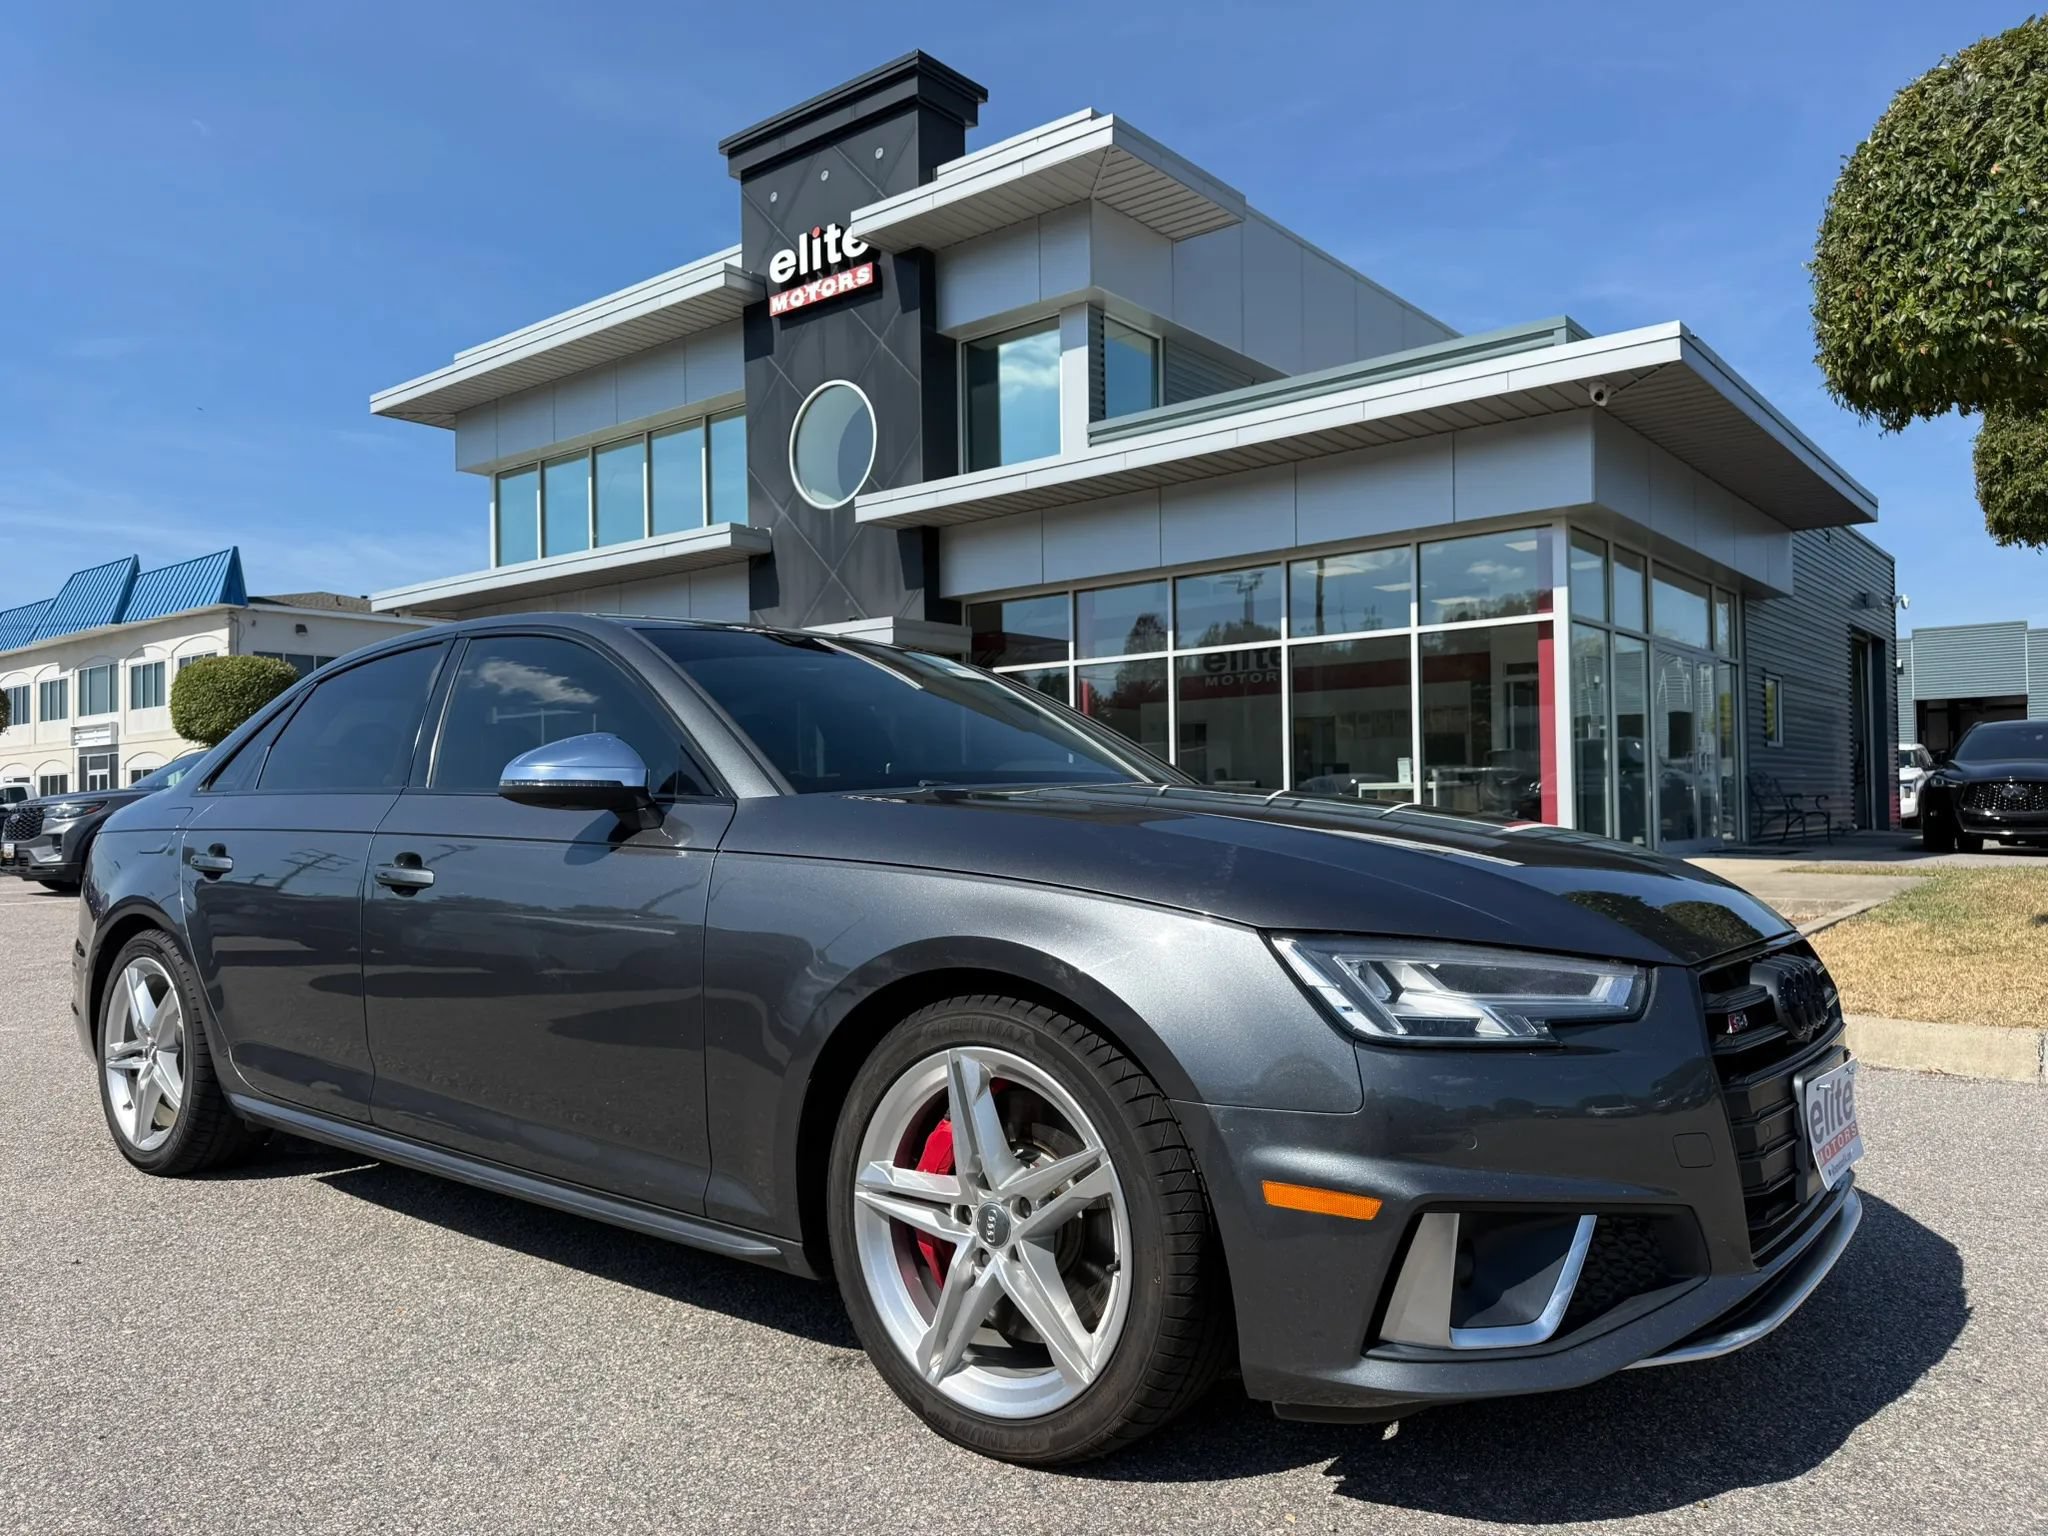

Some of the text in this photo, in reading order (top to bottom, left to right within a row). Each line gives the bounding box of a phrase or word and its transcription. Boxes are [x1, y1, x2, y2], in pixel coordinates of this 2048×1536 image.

[771, 266, 871, 314] MOTORS
[1204, 671, 1278, 688] MOTOR
[1809, 1077, 1854, 1145] elite
